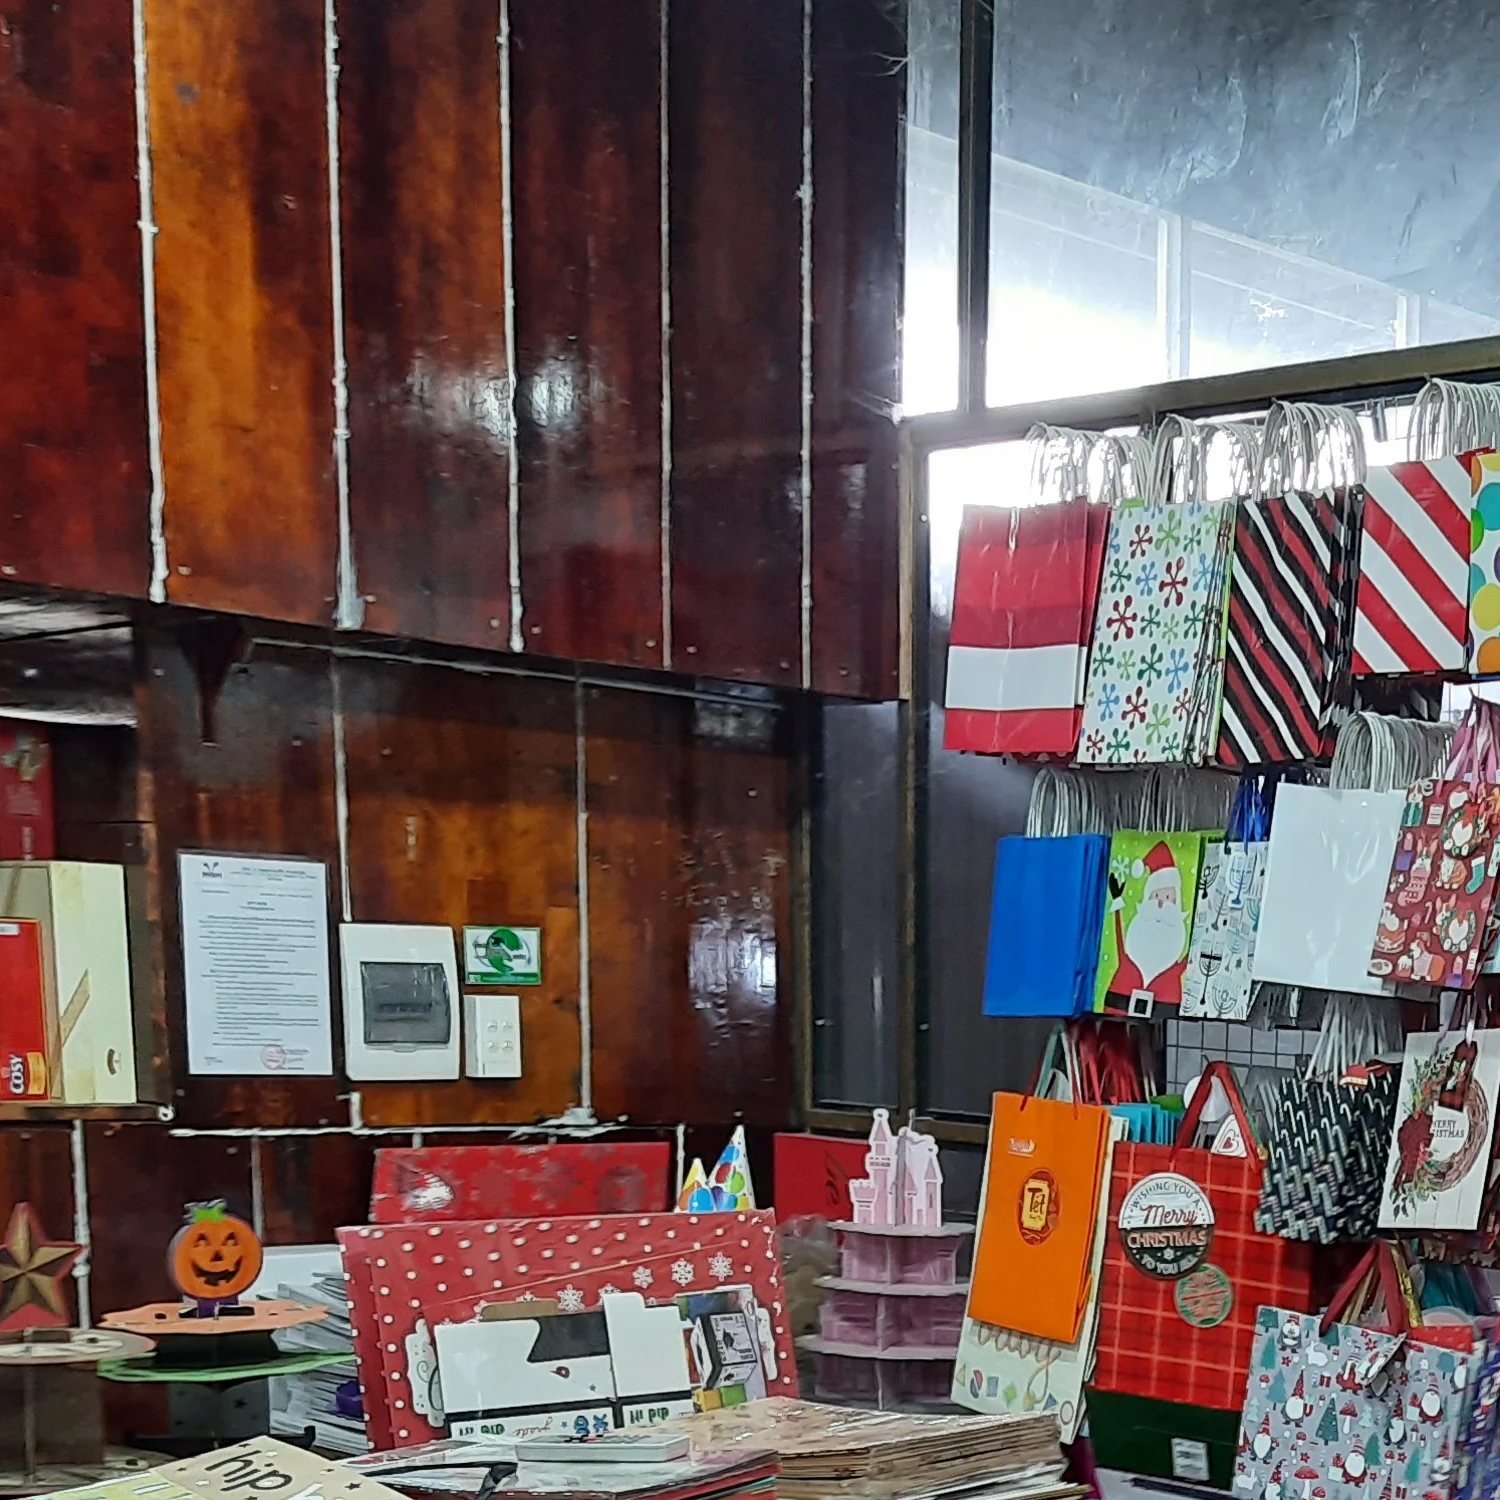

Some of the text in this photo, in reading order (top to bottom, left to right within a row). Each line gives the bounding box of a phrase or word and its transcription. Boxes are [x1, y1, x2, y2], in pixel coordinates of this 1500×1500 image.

[9, 1054, 25, 1095] COSY
[1131, 1181, 1171, 1209] WISHING
[1174, 1183, 1193, 1199] YOU
[1140, 1204, 1198, 1229] Merry
[1127, 1231, 1207, 1248] CHRISTMAS
[1156, 1263, 1179, 1274] YOU
[205, 1450, 294, 1493] hip
